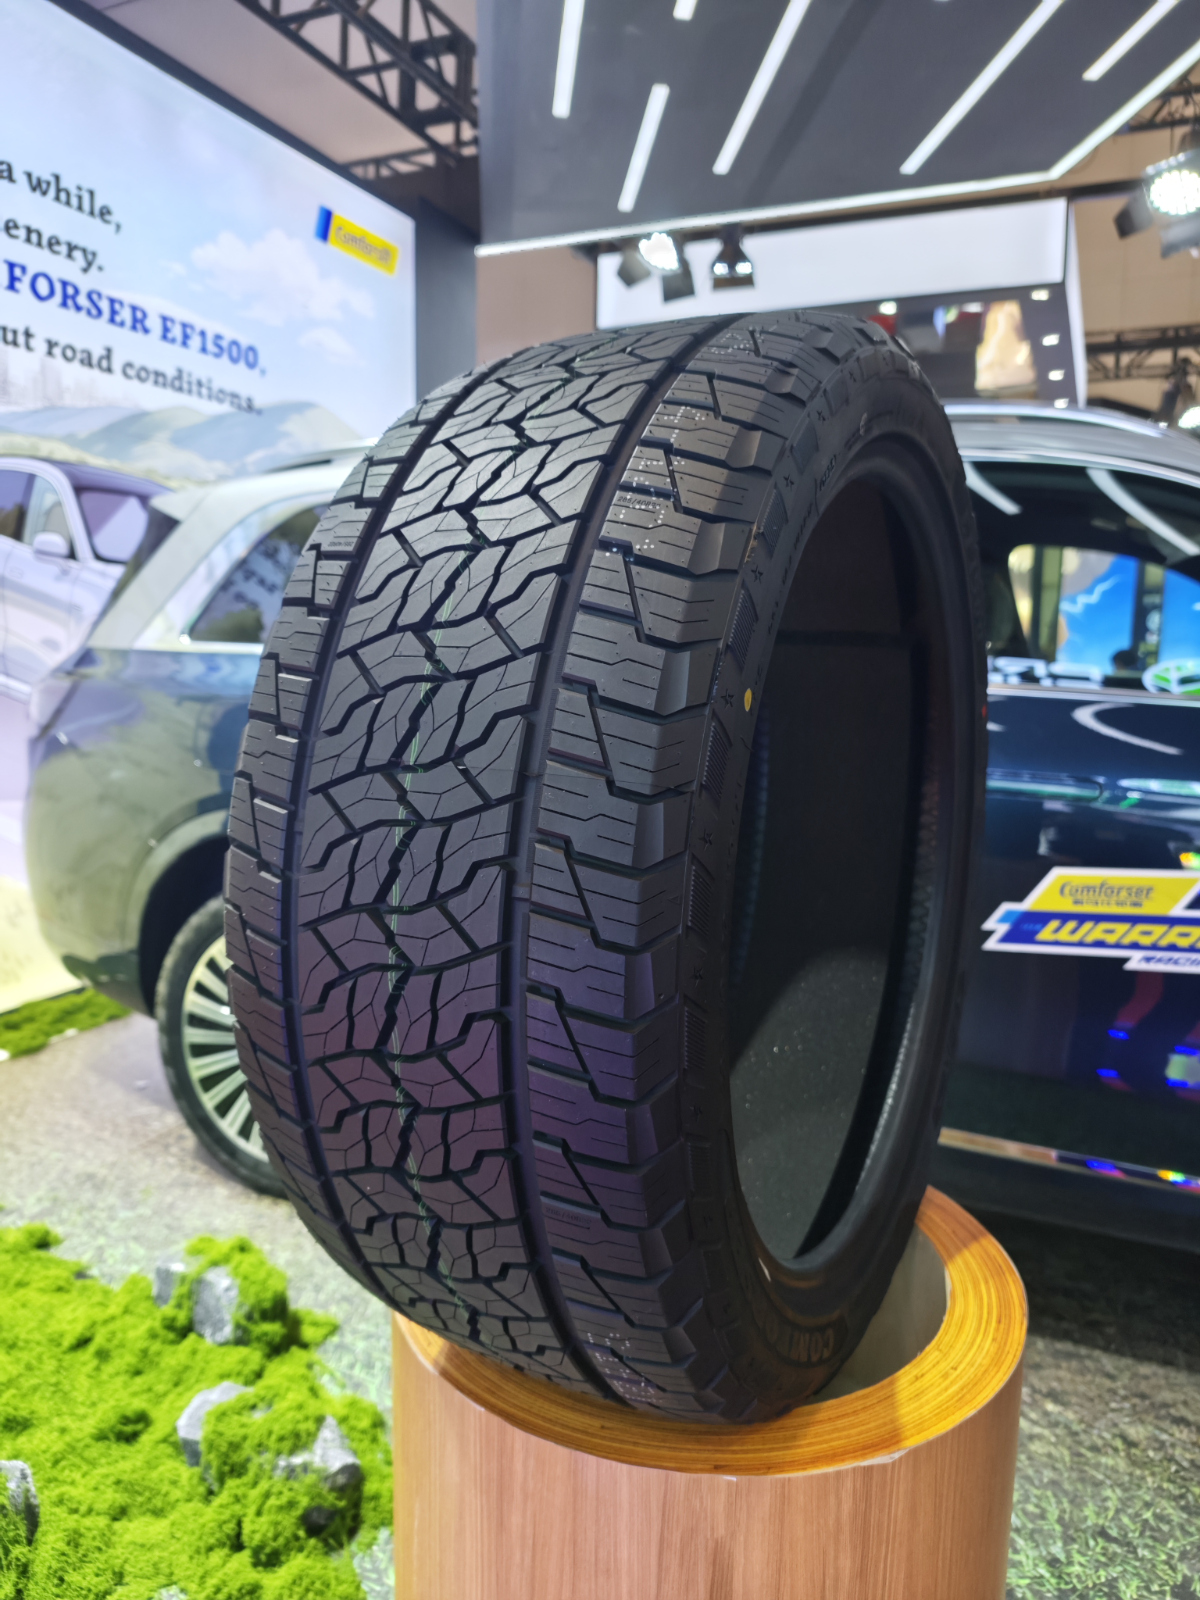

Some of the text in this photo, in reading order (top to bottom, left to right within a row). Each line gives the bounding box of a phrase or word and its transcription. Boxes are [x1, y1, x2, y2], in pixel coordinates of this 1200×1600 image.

[0, 160, 122, 235] a while,
[3, 218, 104, 275] enery.
[3, 258, 151, 335] FORSER
[0, 324, 263, 416] ut road conditions.
[1034, 919, 1200, 949] WARR
